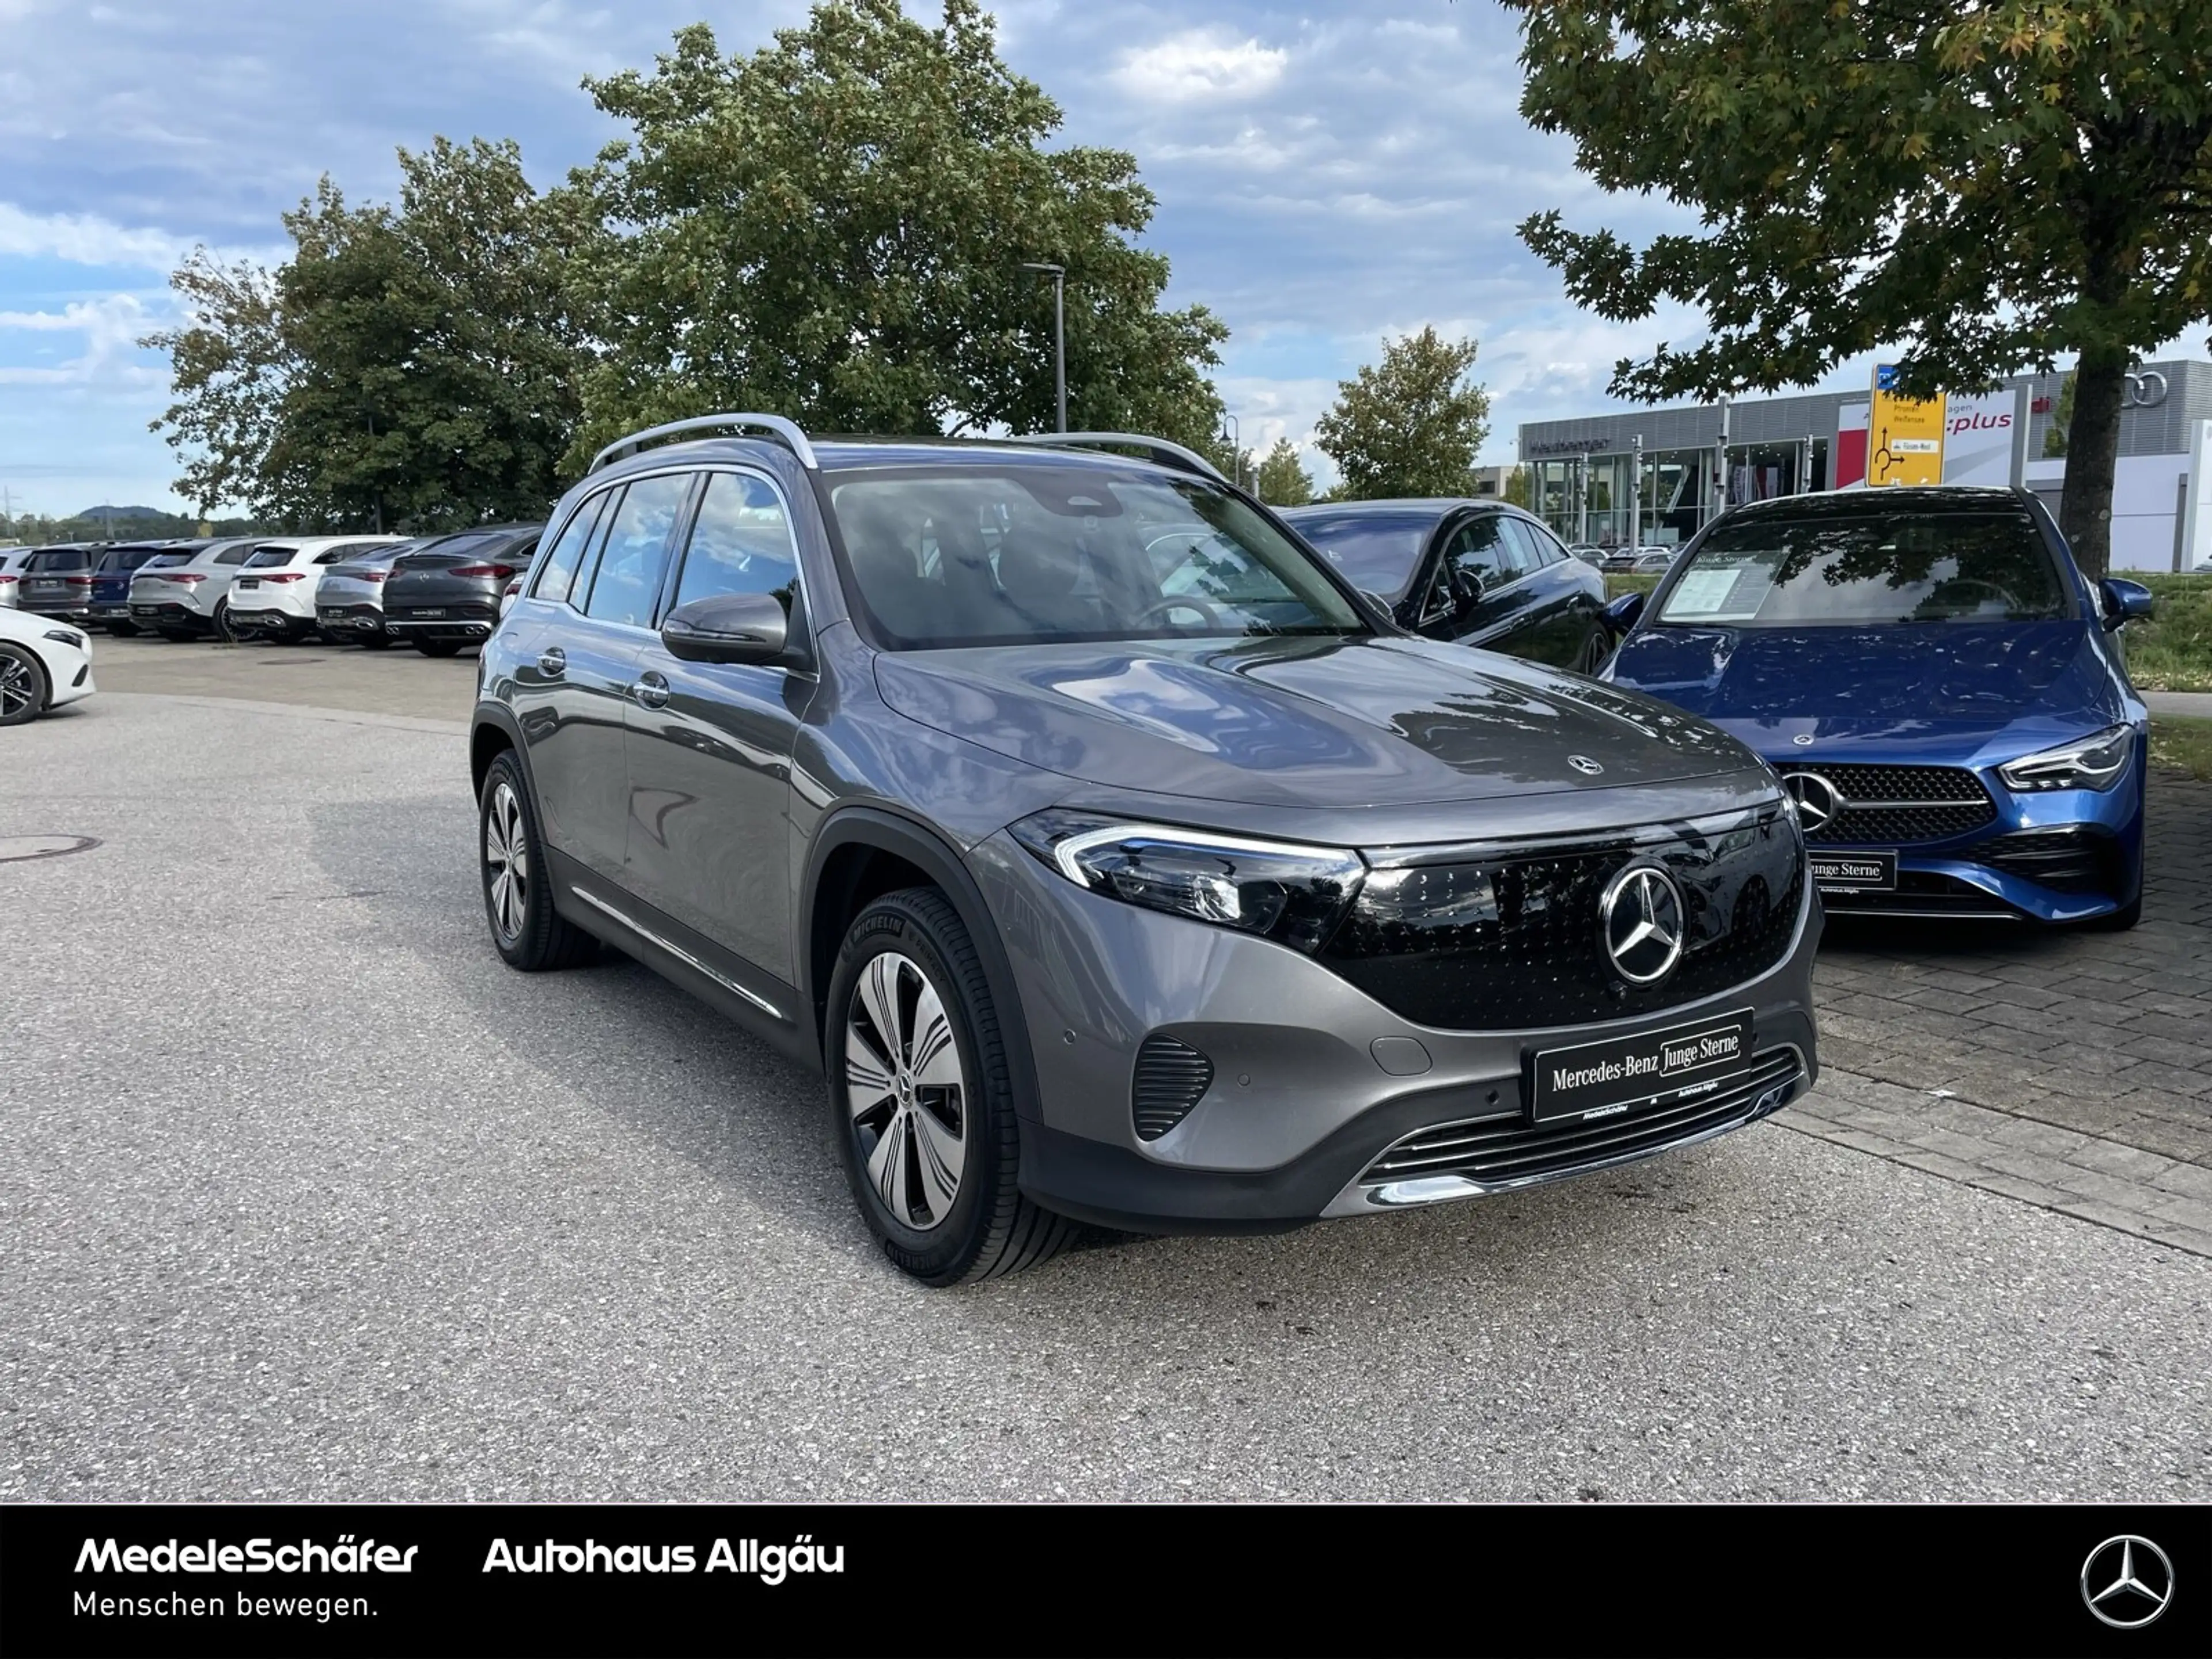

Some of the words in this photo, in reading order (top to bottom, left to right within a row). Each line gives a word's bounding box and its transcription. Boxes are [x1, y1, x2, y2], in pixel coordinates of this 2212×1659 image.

[1947, 403, 1972, 414] agen
[2031, 396, 2051, 413] di
[1811, 865, 1839, 876] unge
[1841, 863, 1880, 876] Sterne
[853, 915, 903, 943] MICHELIN
[1552, 1055, 1658, 1092] Mercedes-Benz
[1662, 1046, 1698, 1072] Junge
[1700, 1035, 1739, 1059] Sterne
